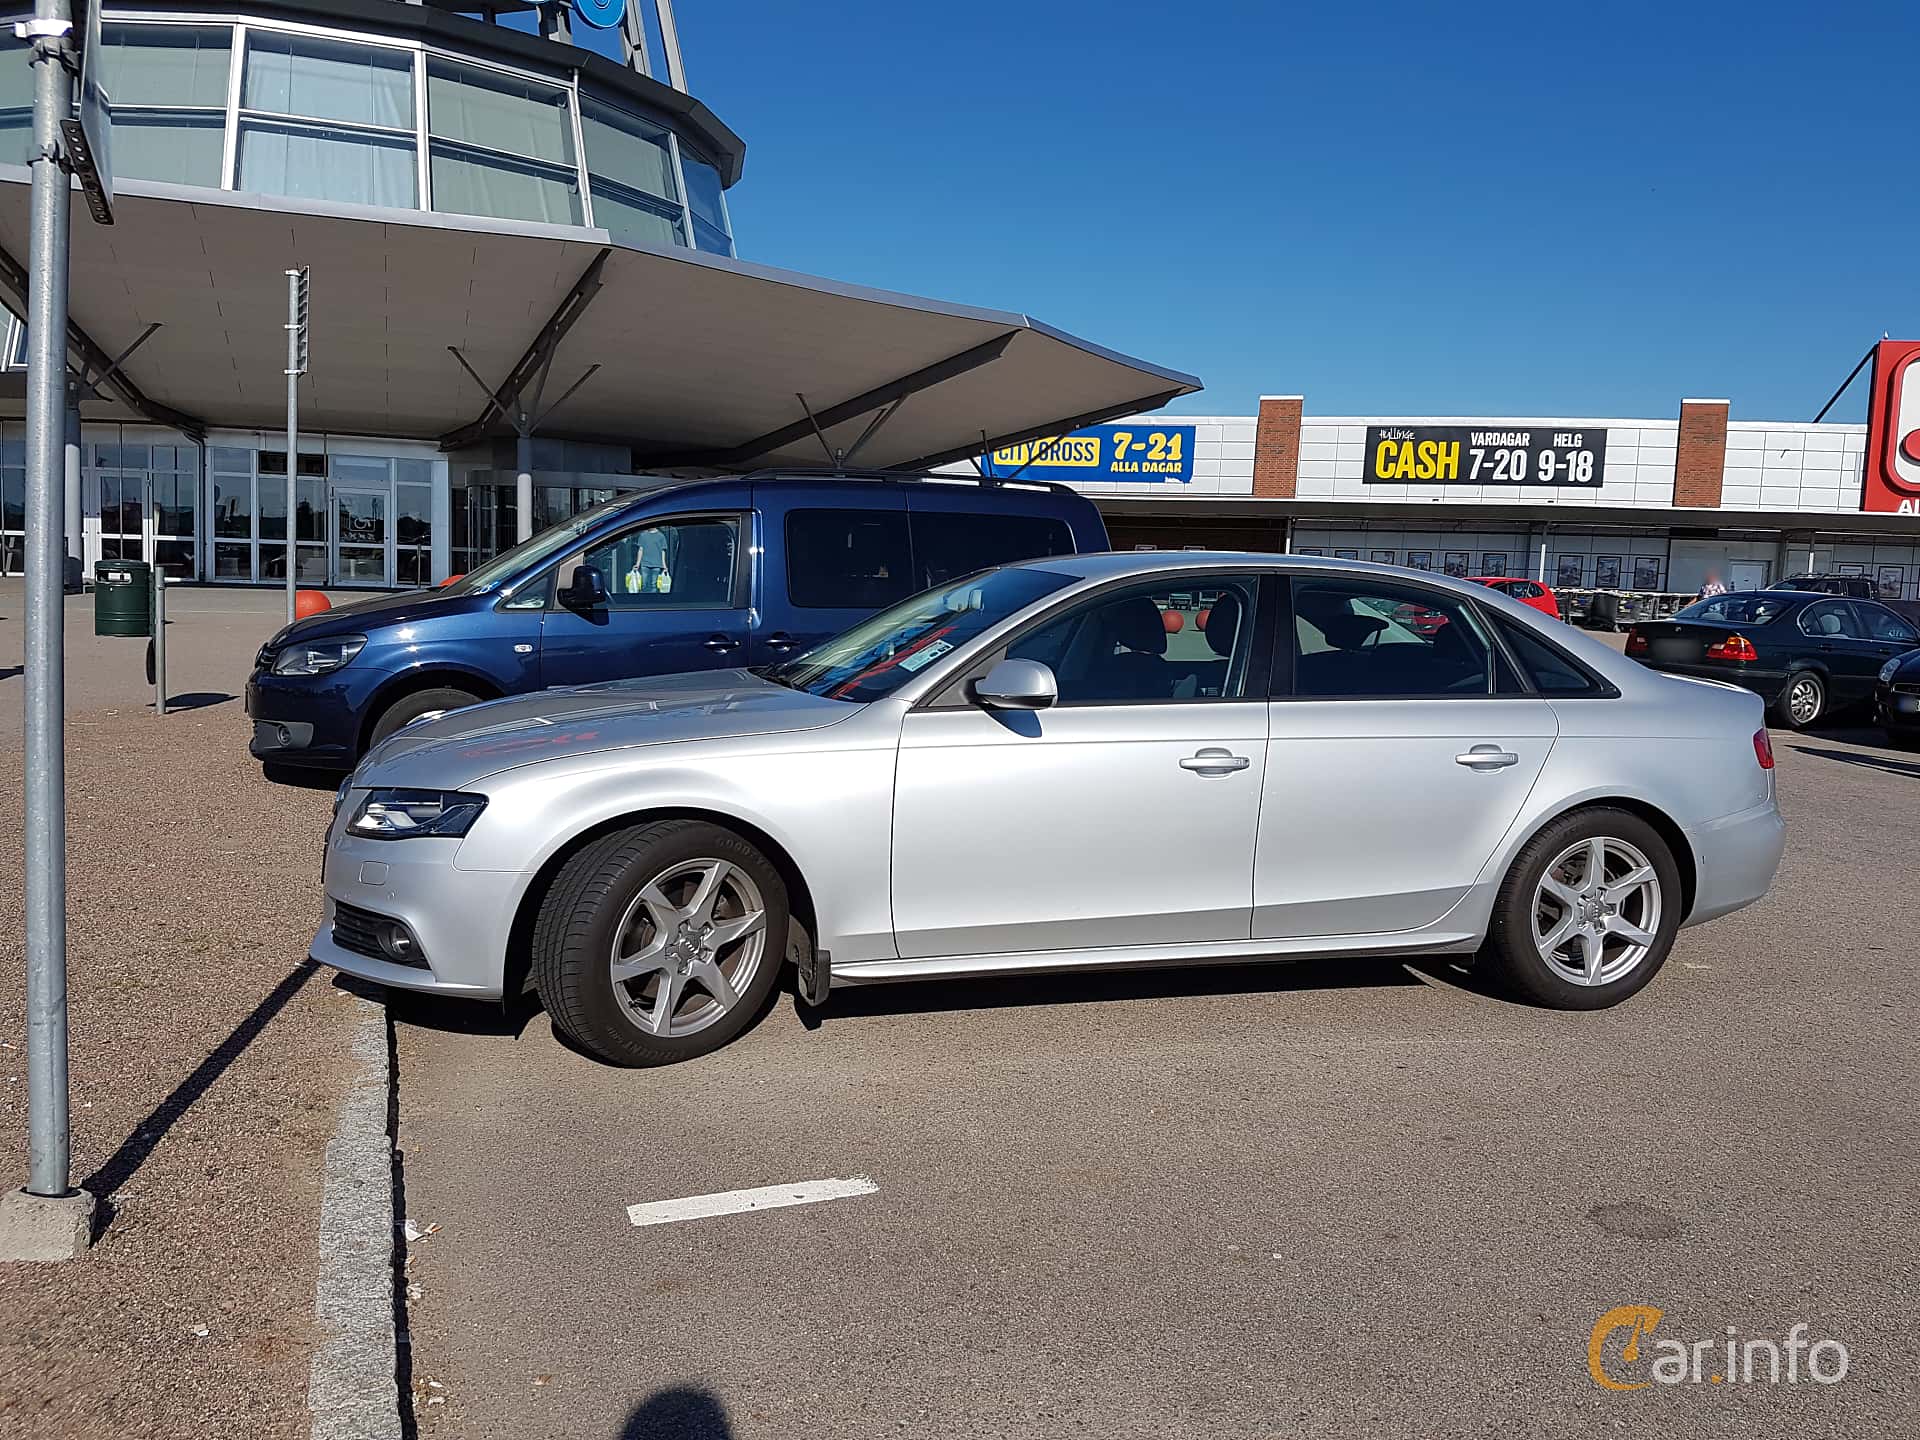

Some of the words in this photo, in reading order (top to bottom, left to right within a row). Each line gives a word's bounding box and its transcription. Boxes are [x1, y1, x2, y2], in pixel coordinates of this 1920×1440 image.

[1112, 431, 1183, 461] 7-21
[1471, 432, 1530, 447] VARDAGAR
[1553, 433, 1583, 448] HELG
[1110, 461, 1139, 473] ALLA
[1142, 462, 1183, 474] DAGAR
[1375, 440, 1461, 480] CASH
[1469, 449, 1528, 481] 7-20
[1537, 449, 1594, 482] 9-18
